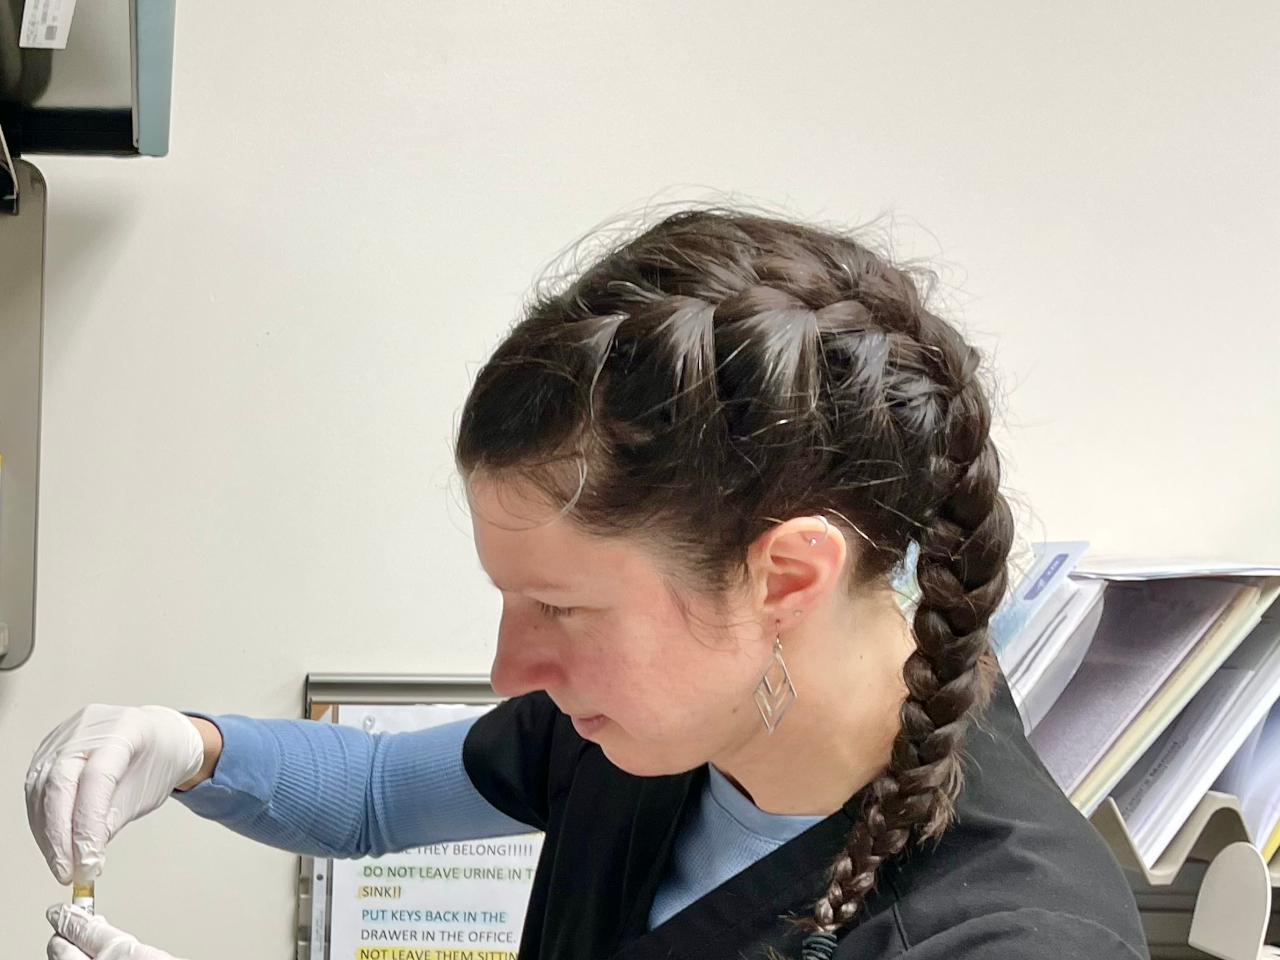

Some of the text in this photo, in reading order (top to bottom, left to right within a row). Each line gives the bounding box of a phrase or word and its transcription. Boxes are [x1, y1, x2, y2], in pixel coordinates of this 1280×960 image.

[363, 866, 383, 878] DO
[387, 866, 415, 879] NOT
[419, 867, 459, 880] LEAVE
[463, 867, 504, 880] URINE
[508, 868, 522, 880] IN
[361, 910, 506, 923] PUT KEYS BACK IN THE
[361, 930, 517, 943] DRAWER IN THE OFFICE.
[360, 949, 388, 960] NOT
[392, 950, 431, 960] LEAVE
